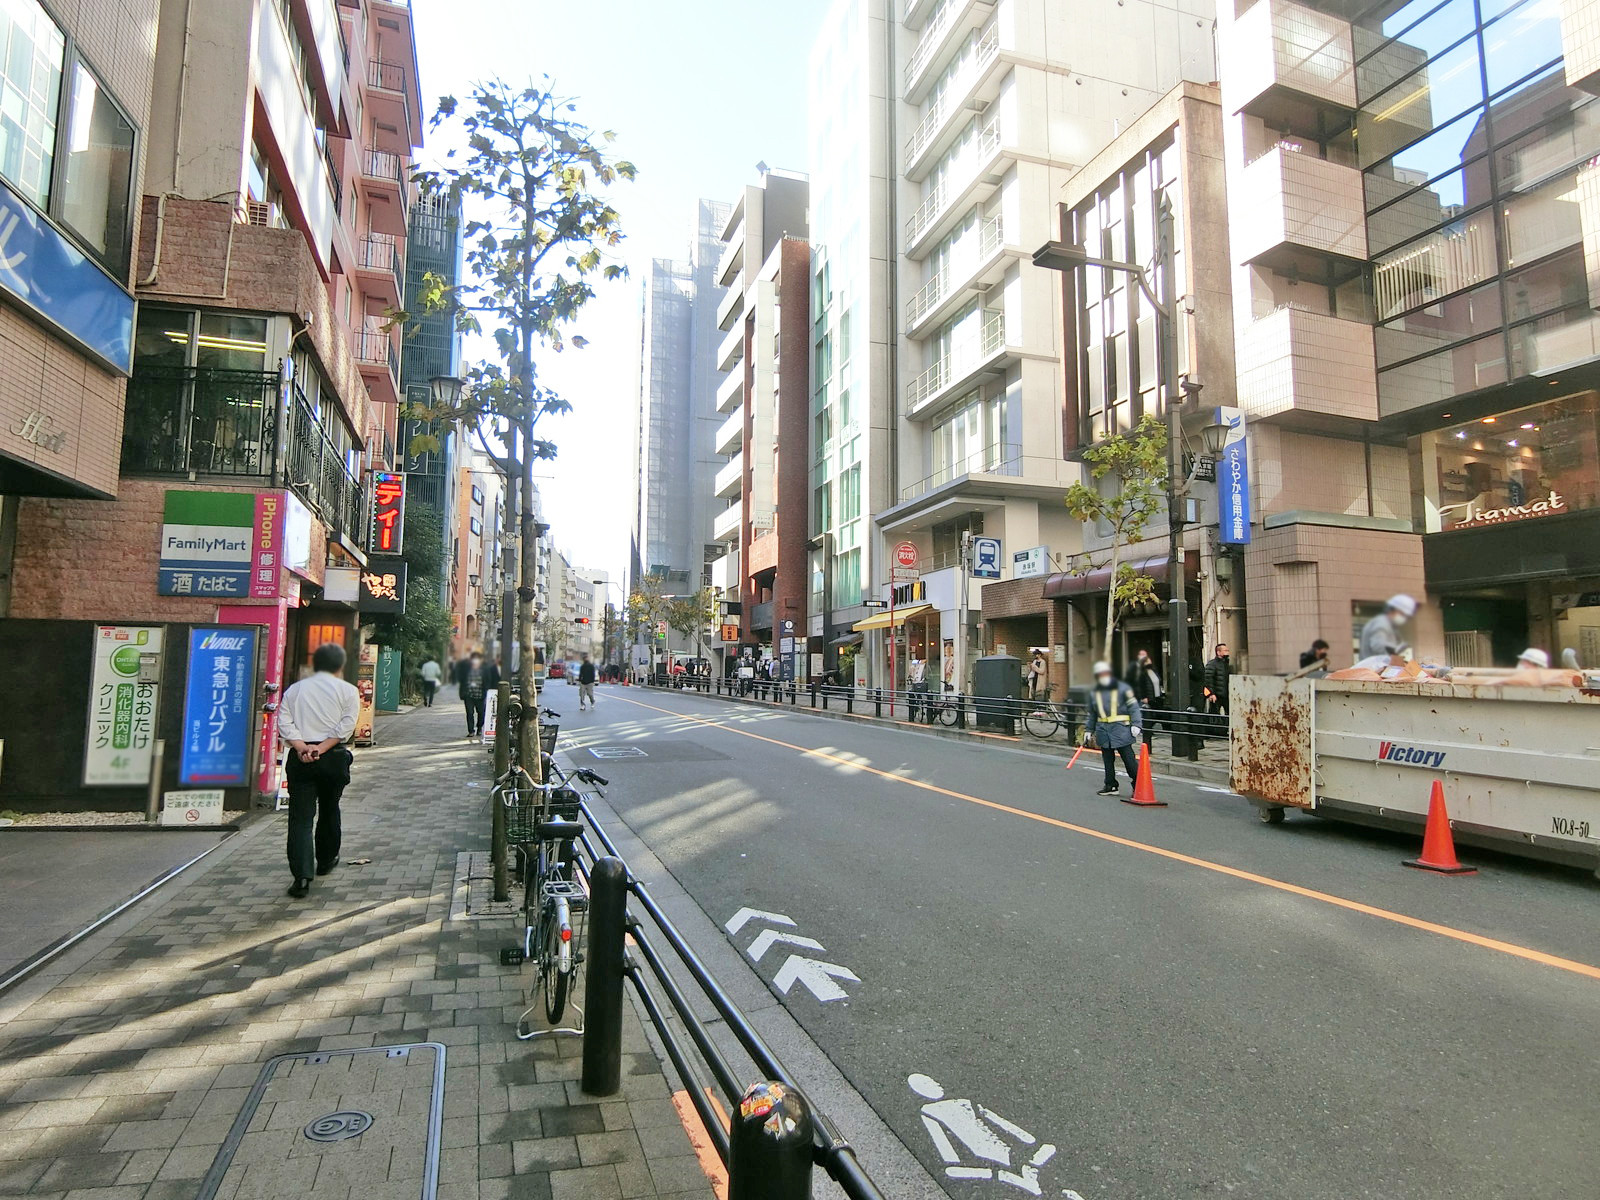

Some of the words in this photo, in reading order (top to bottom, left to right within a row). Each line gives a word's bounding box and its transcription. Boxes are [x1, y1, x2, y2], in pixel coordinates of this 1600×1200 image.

[1230, 447, 1244, 540] さわやか信用金庫
[1438, 490, 1565, 525] Tiamat
[260, 497, 277, 549] iPhone
[376, 483, 402, 549] ティー
[167, 536, 246, 552] FamilyMart
[171, 572, 193, 594] 酒
[197, 575, 237, 592] たばこ
[258, 552, 275, 582] 修理
[95, 683, 114, 749] クリニック
[115, 686, 133, 746] 消化器内科
[132, 683, 153, 750] おおたけ
[207, 655, 232, 753] 東急リバブル
[110, 755, 131, 769] 4F
[1378, 741, 1446, 767] Victory
[1551, 816, 1590, 838] NO.8-50
